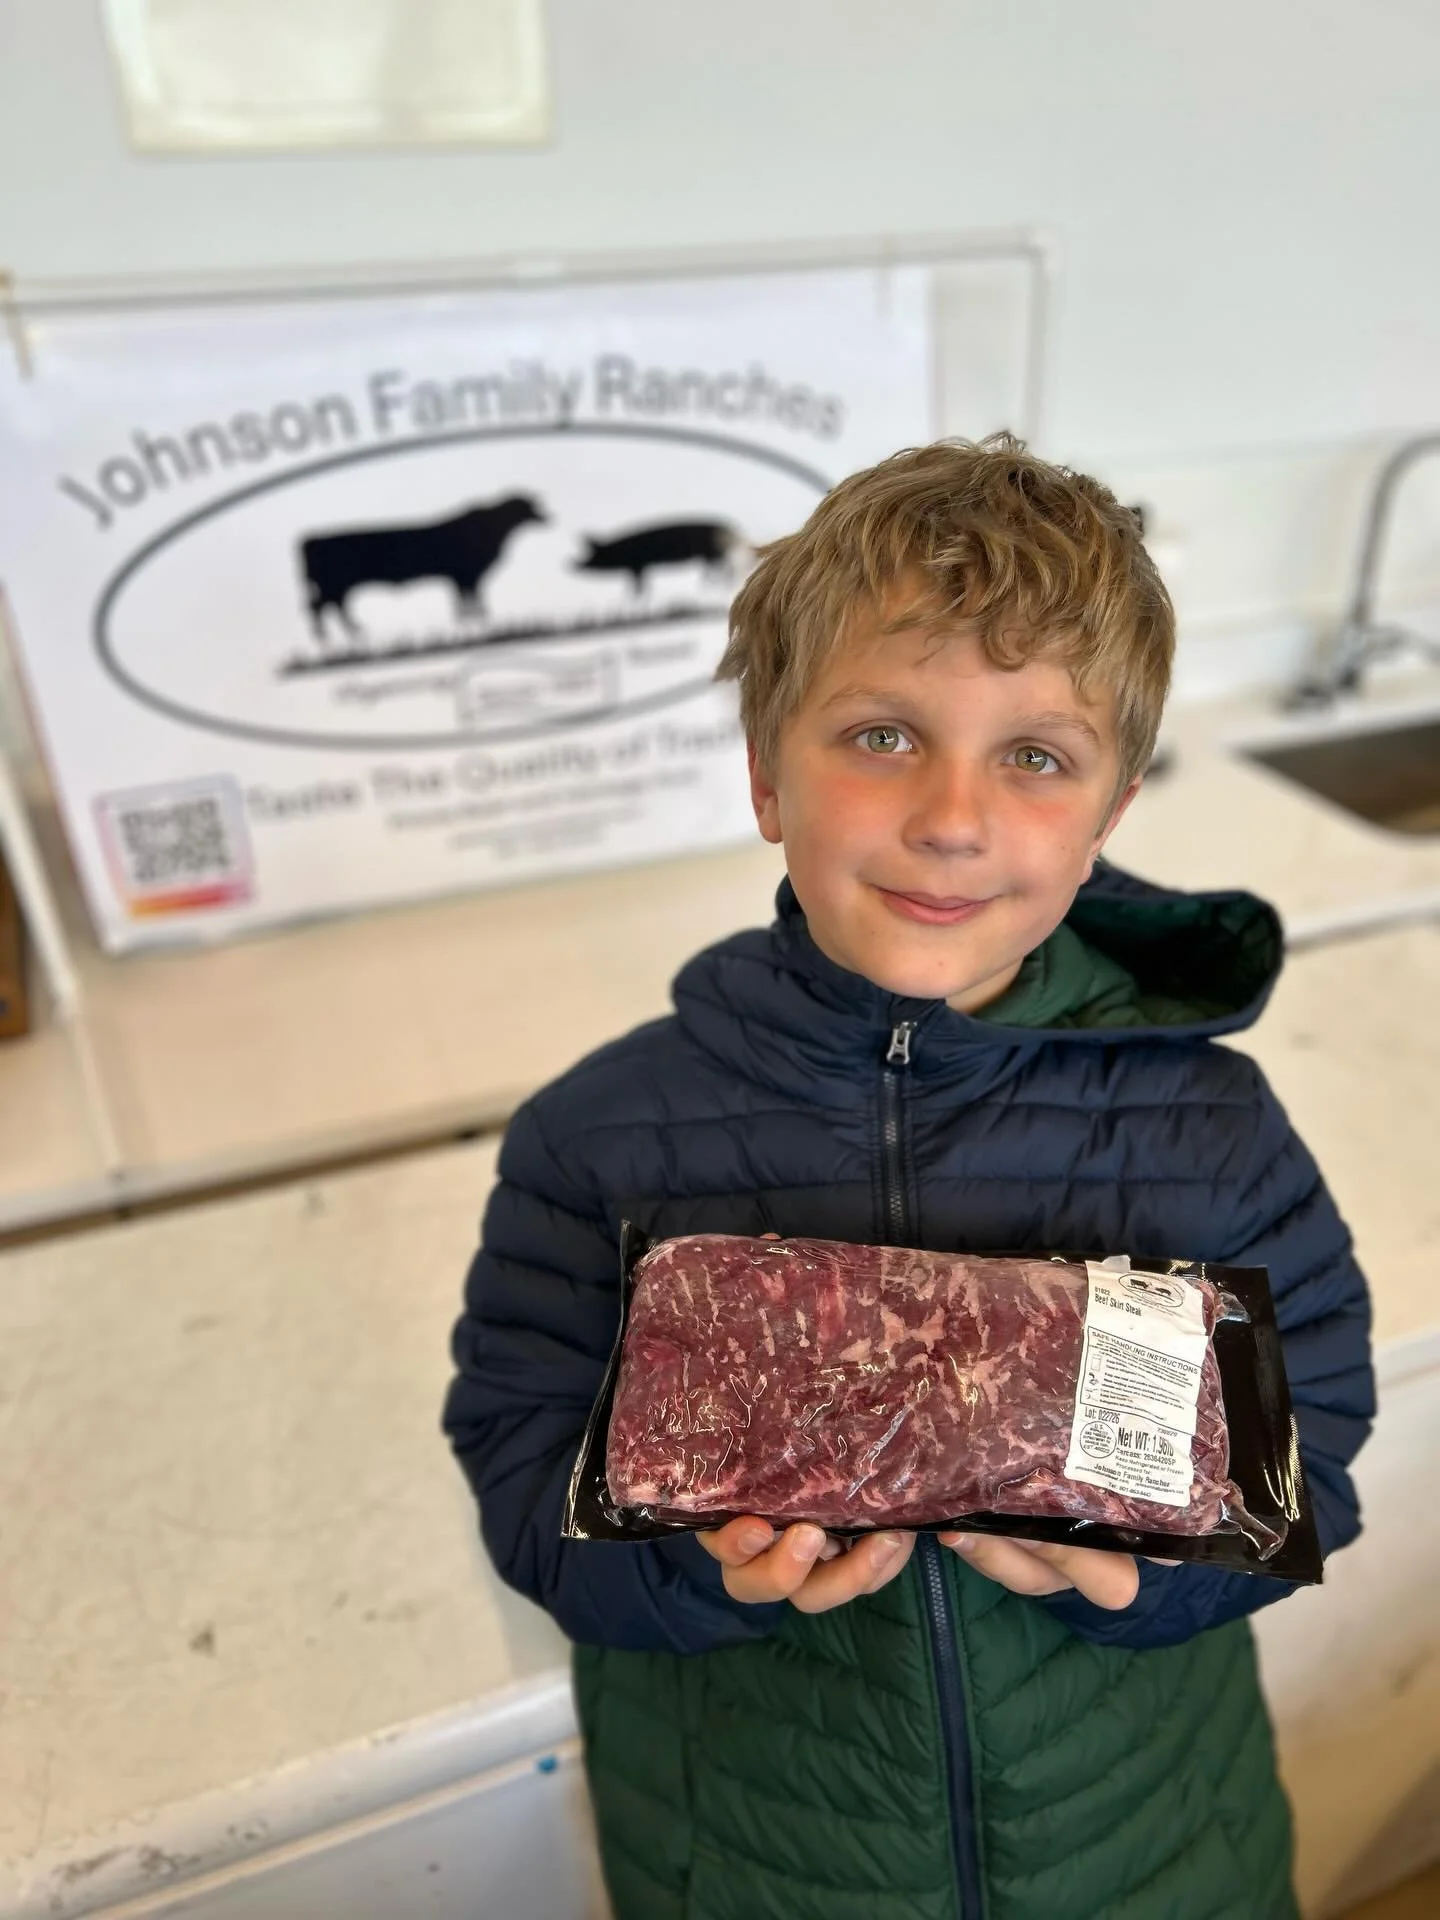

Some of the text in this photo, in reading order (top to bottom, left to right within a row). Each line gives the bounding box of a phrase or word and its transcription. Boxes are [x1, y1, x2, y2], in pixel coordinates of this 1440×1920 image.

[57, 353, 846, 531] Johnson Family Ranches
[1094, 1293, 1108, 1306] Beef
[1109, 1297, 1124, 1310] Skirt
[1125, 1303, 1142, 1316] Steak
[1092, 1331, 1110, 1341] SAFE
[1111, 1337, 1145, 1357] HANDLING
[1146, 1352, 1198, 1375] INSTRUCTIONS
[1084, 1406, 1097, 1419] Lot:
[1117, 1427, 1132, 1448] Net
[1094, 1464, 1121, 1477] Johnson
[1123, 1471, 1144, 1483] Family
